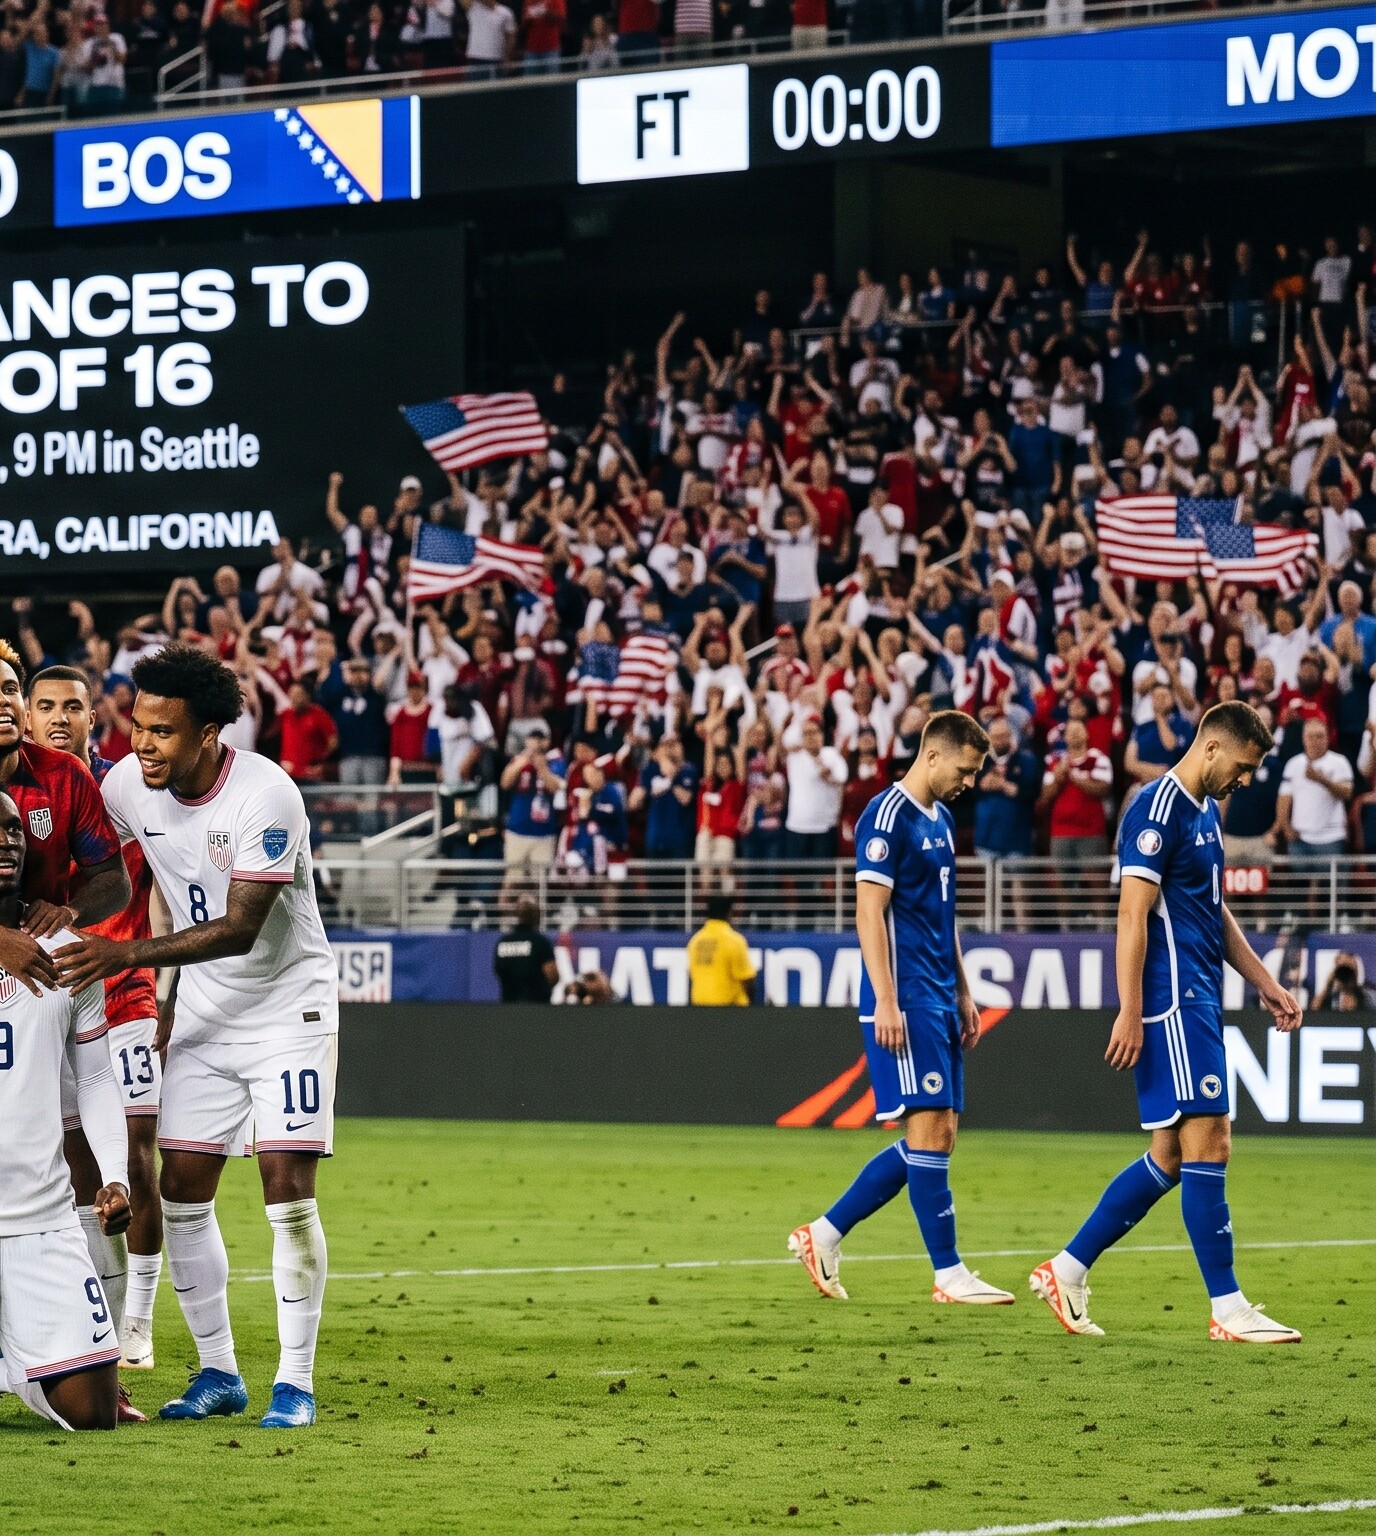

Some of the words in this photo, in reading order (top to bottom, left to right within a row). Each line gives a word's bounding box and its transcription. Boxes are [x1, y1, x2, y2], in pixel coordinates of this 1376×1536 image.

[636, 90, 689, 159] FT
[772, 65, 941, 151] 00:00
[82, 132, 232, 209] BOS
[251, 261, 369, 327] TO
[123, 341, 214, 408] 16
[12, 431, 38, 478] 9
[42, 429, 97, 476] PM
[102, 428, 135, 474] in
[139, 422, 261, 472] Seattle
[54, 510, 281, 554] CALIFORNIA
[188, 883, 209, 925] 8
[118, 1045, 155, 1086] 13
[280, 1068, 321, 1115] 10
[1223, 1026, 1376, 1123] NE
[83, 1276, 110, 1324] 9
